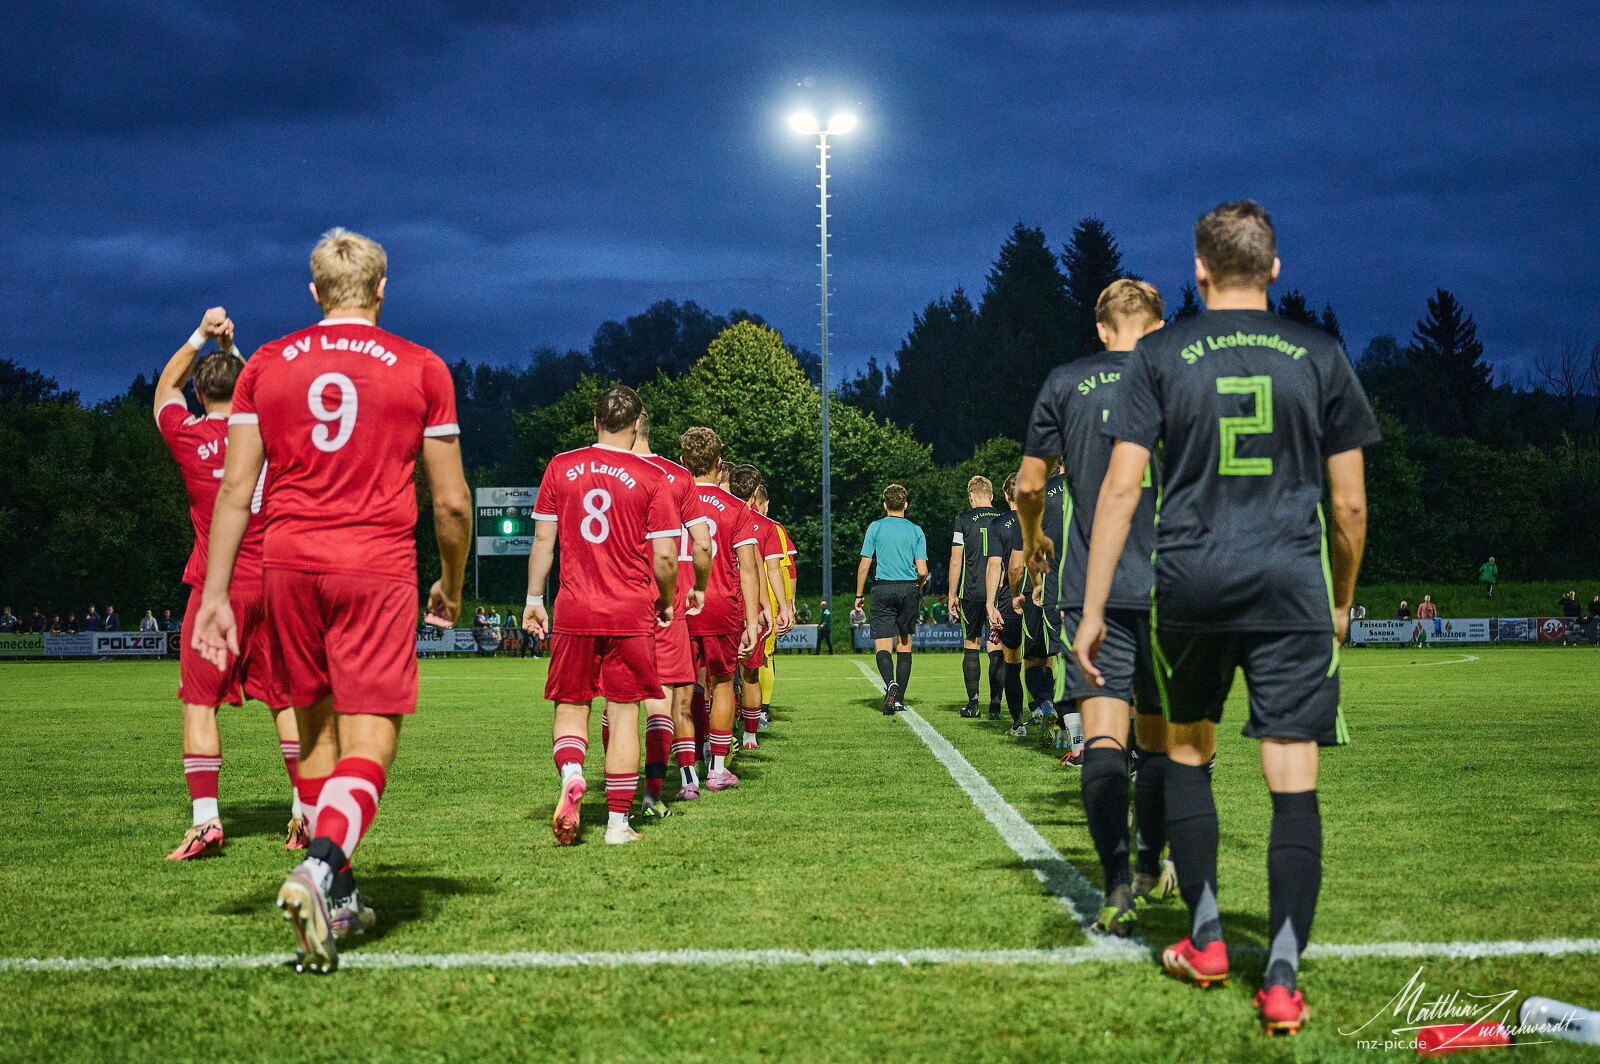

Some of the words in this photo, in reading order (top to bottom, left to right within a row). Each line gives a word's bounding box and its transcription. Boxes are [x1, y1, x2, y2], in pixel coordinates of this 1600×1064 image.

[282, 336, 311, 361] SV
[320, 335, 398, 367] Laufen
[1181, 340, 1206, 364] SV
[1206, 331, 1308, 360] Leobendorf
[1077, 376, 1097, 396] SV
[307, 372, 358, 452] 9
[1216, 375, 1273, 476] 2
[197, 439, 219, 460] SV
[566, 462, 585, 481] SV
[590, 461, 637, 490] Laufen
[1047, 487, 1057, 497] SV
[480, 508, 503, 517] HEIM
[580, 488, 612, 544] 8
[1004, 519, 1012, 529] SV
[980, 527, 988, 556] 1
[1547, 622, 1561, 633] SV
